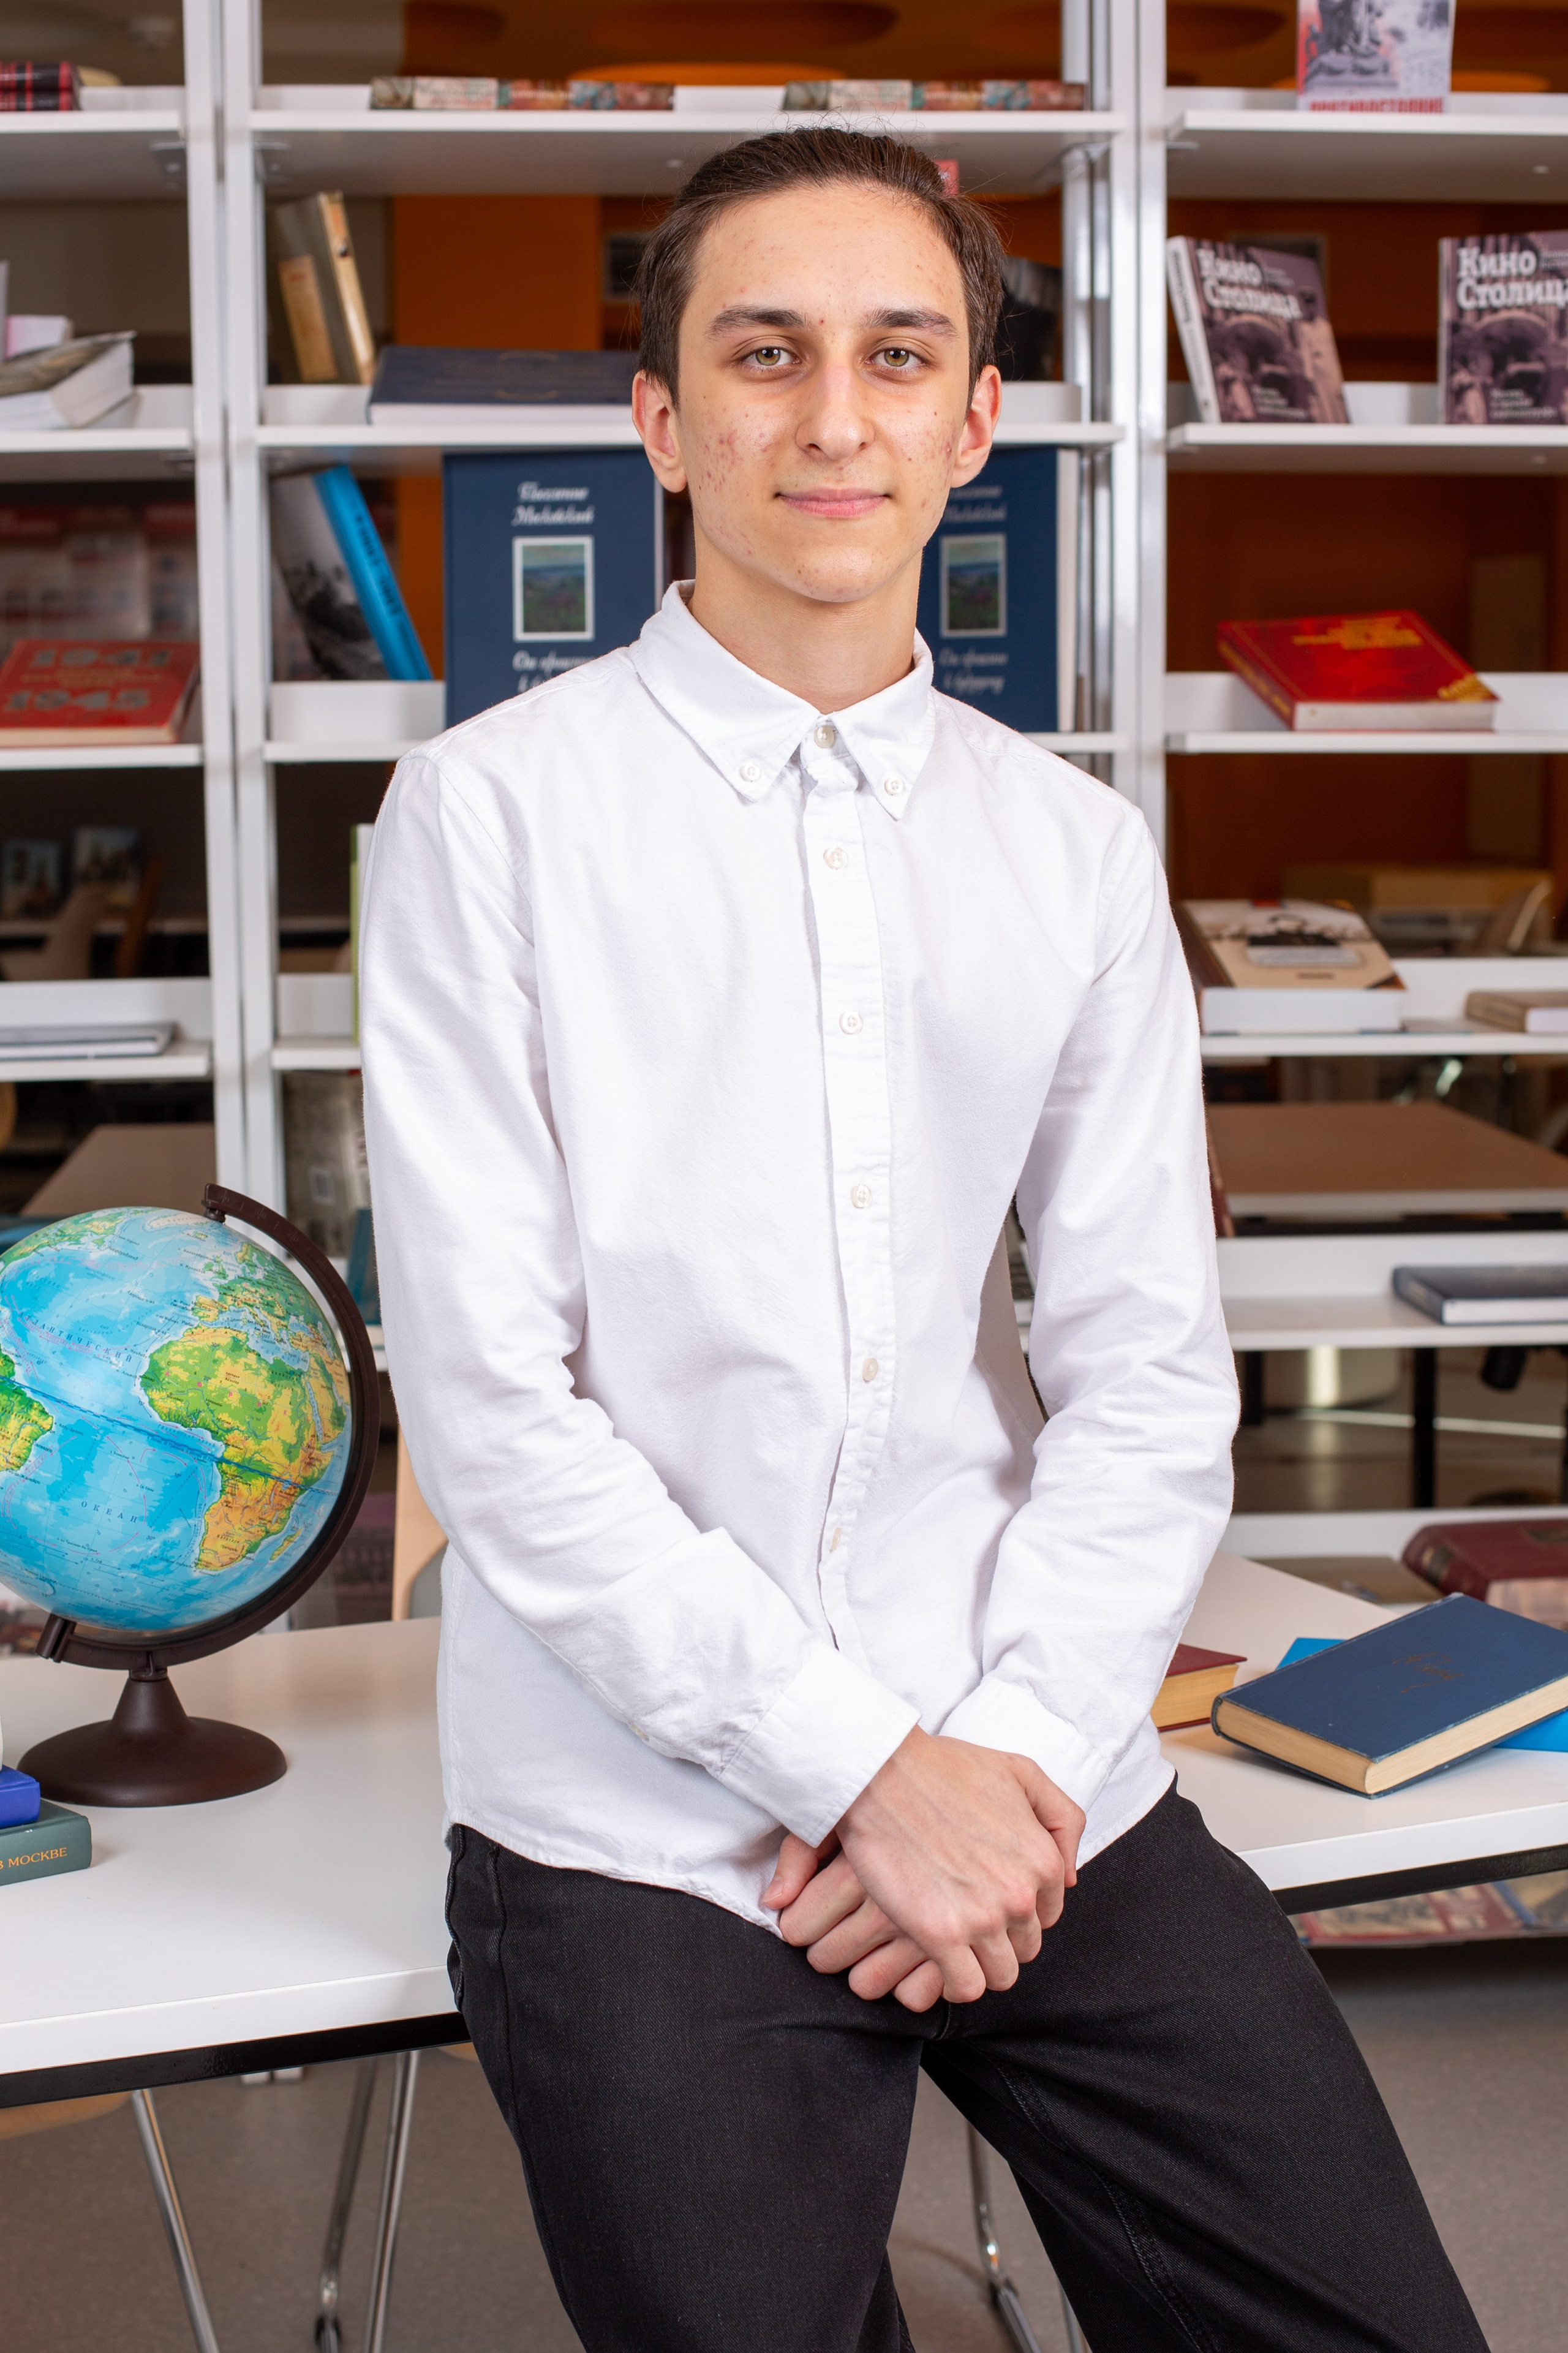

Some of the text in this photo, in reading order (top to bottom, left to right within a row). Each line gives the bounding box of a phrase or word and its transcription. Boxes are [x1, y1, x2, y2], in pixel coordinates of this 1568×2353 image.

[1196, 247, 1264, 287] Кино
[1457, 246, 1537, 276] Кино
[1202, 277, 1303, 320] Столица
[3, 690, 150, 711] 1945
[141, 1373, 156, 1383] Дакар
[81, 1501, 138, 1524] ОКЕАН
[8, 1847, 67, 1867] МОСКВЕ
